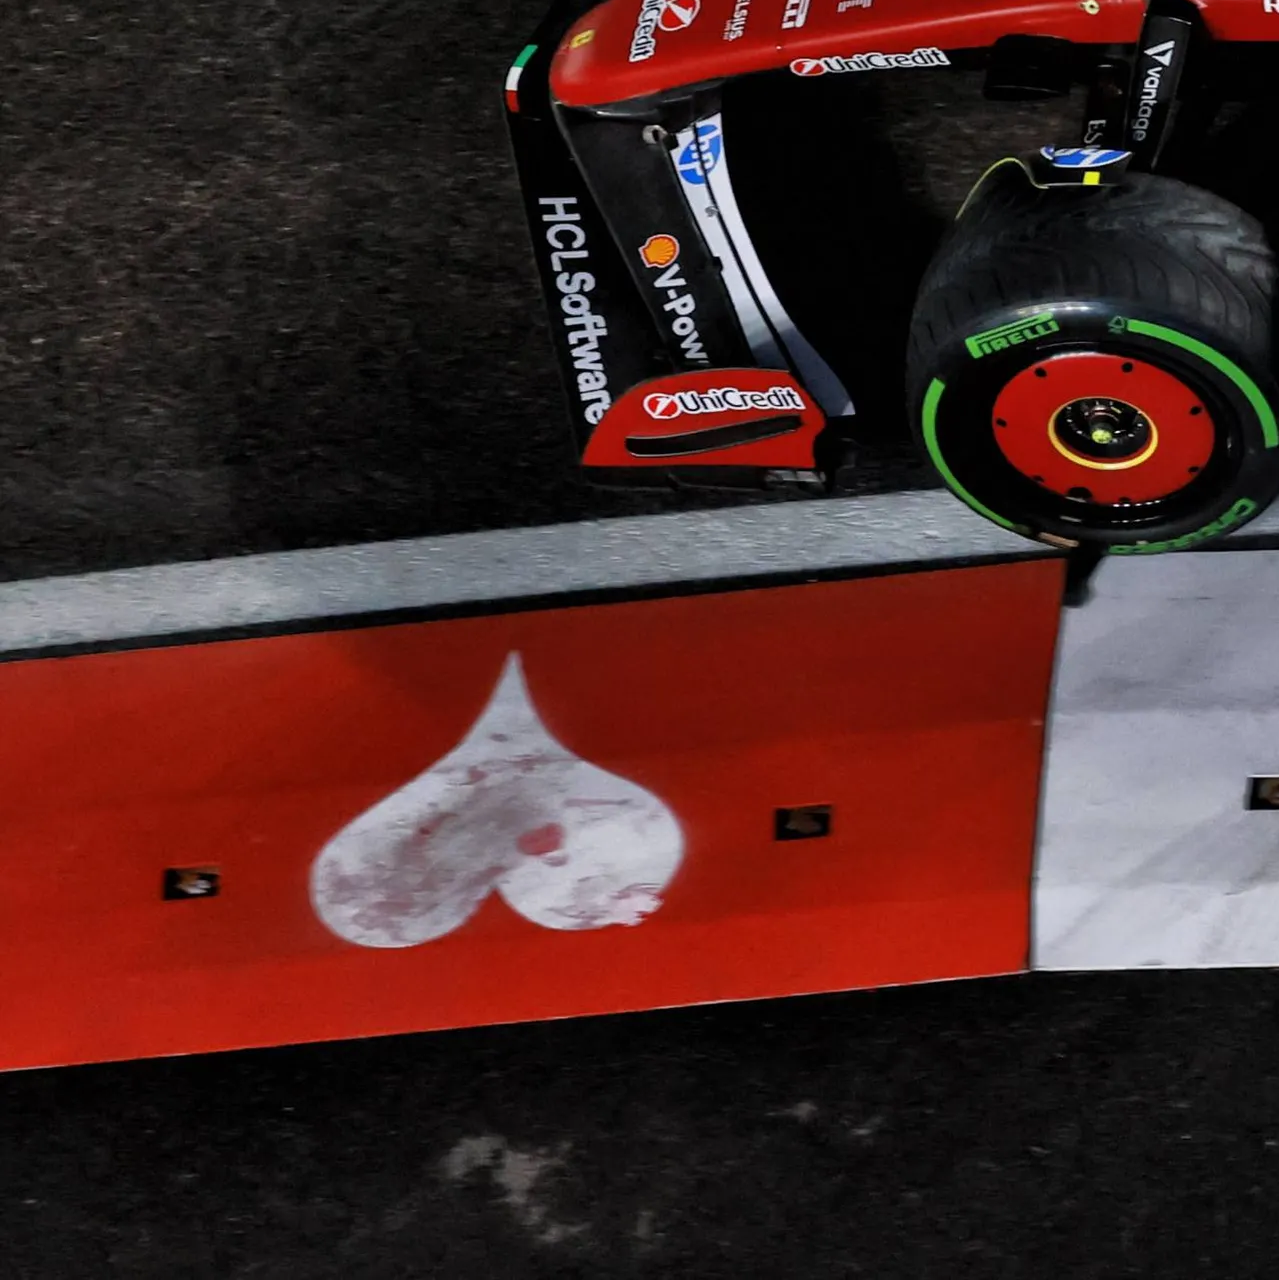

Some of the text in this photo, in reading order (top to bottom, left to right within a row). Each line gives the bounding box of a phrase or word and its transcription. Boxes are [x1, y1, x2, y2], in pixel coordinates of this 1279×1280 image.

[823, 47, 951, 73] UniCredit
[1132, 68, 1163, 141] vantage
[679, 122, 721, 185] hp
[653, 265, 710, 365] V-Pow
[965, 313, 1059, 359] PIRELLI
[679, 386, 805, 415] UniCredit
